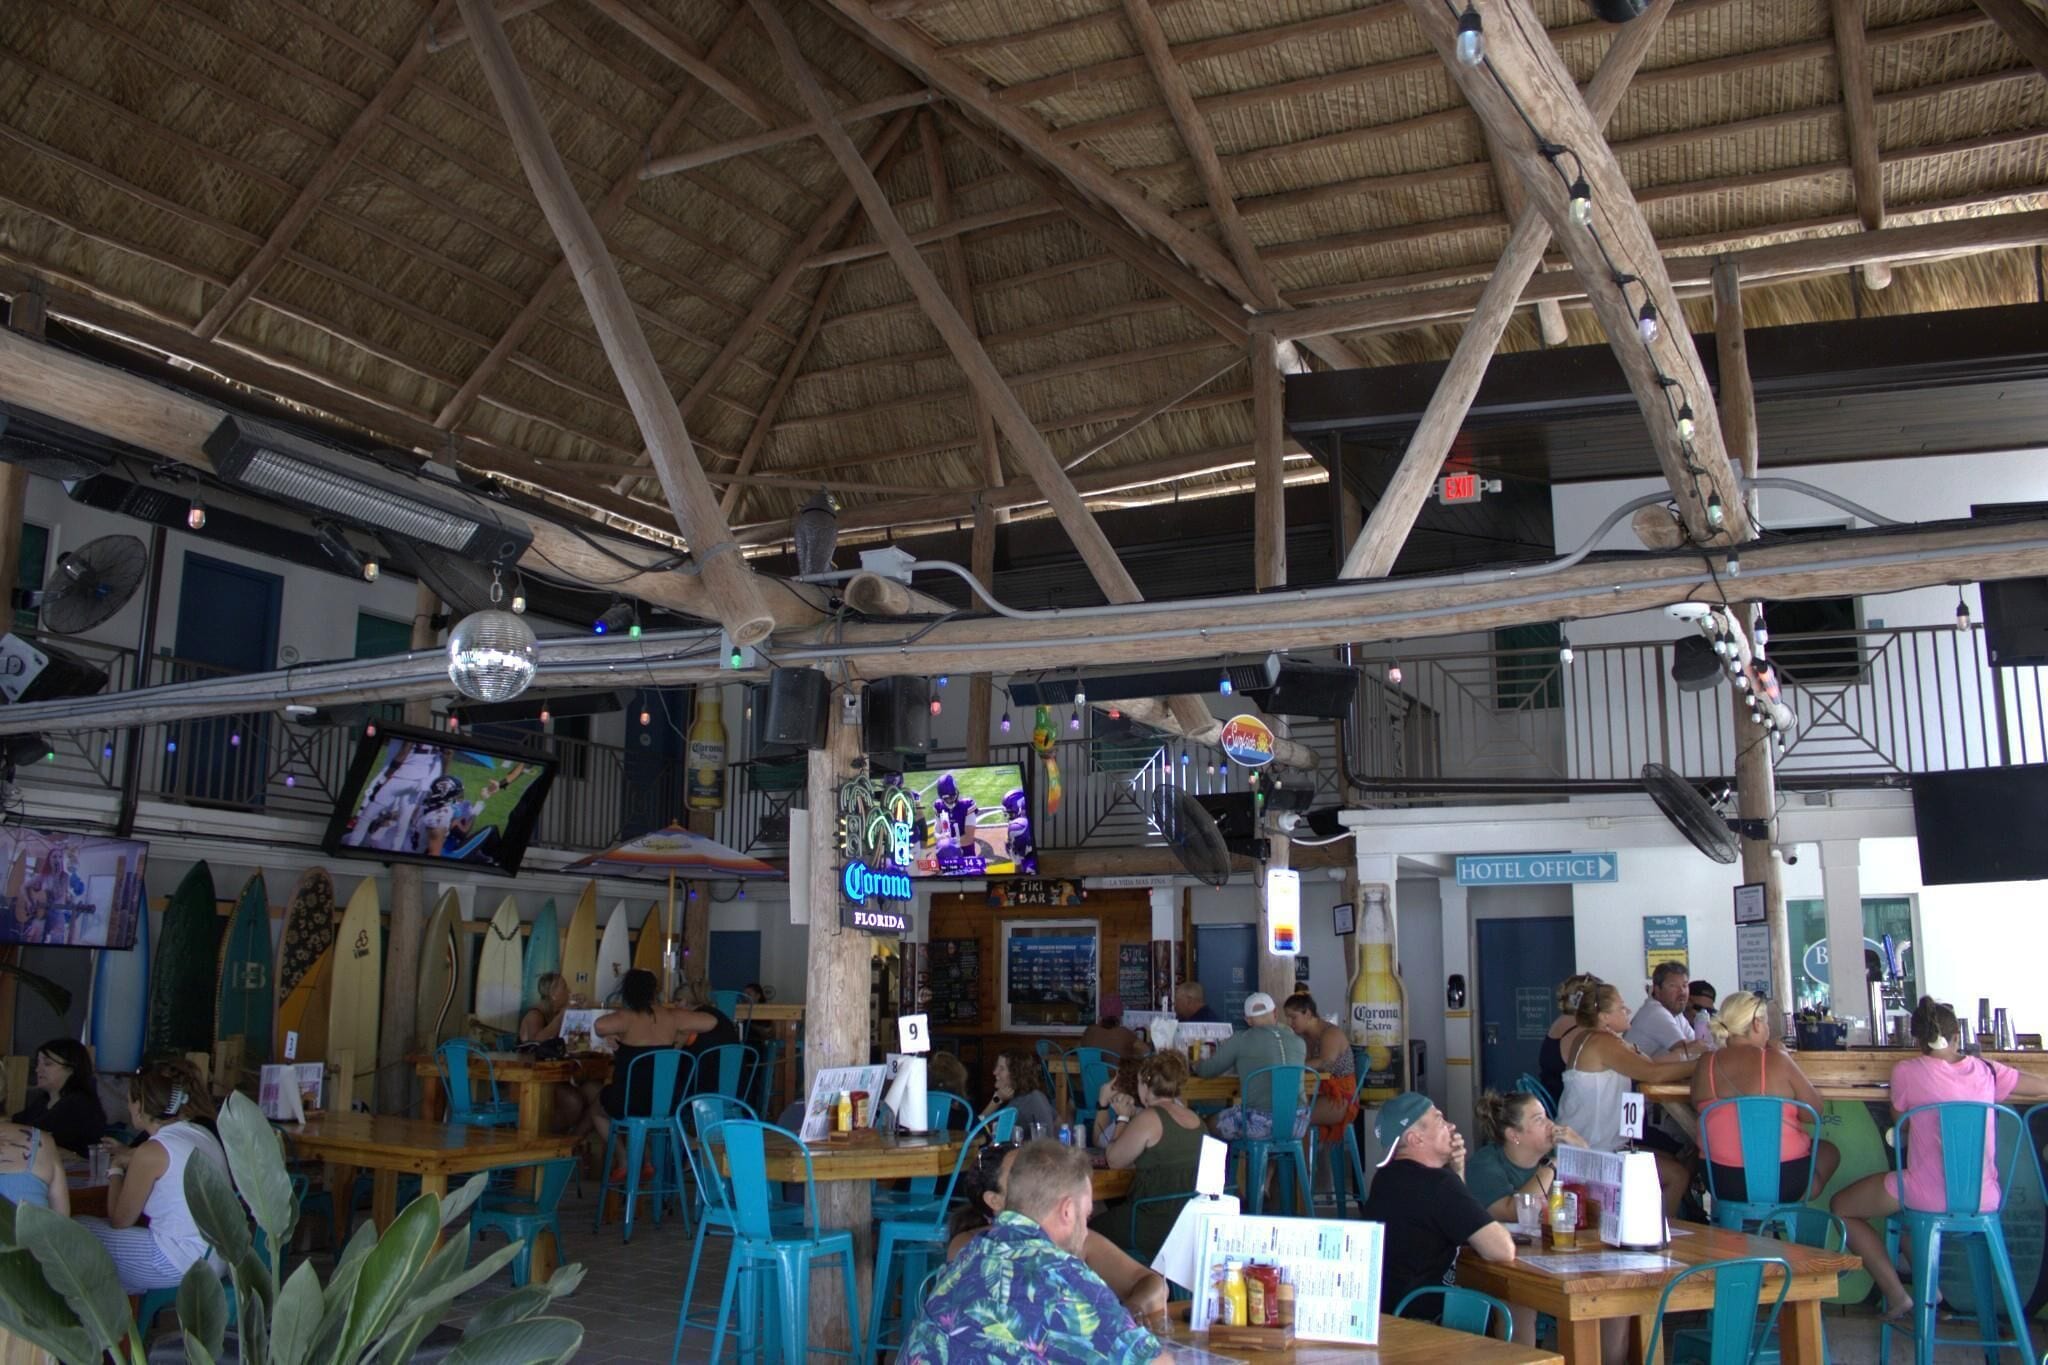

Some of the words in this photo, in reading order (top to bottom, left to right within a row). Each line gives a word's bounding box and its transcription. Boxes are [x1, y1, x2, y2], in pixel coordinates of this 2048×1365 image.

[1446, 477, 1473, 499] EXIT
[691, 743, 723, 753] Corona
[964, 859, 974, 867] 14
[1461, 863, 1525, 880] HOTEL
[1529, 860, 1597, 878] OFFICE
[845, 861, 912, 905] Corona
[1019, 893, 1046, 903] BAR
[855, 912, 905, 929] FLORIDA
[1354, 1006, 1399, 1023] Corona
[909, 1023, 918, 1041] 9
[1366, 1020, 1392, 1031] Extra
[892, 1060, 898, 1073] 8
[1623, 1102, 1637, 1125] 10
